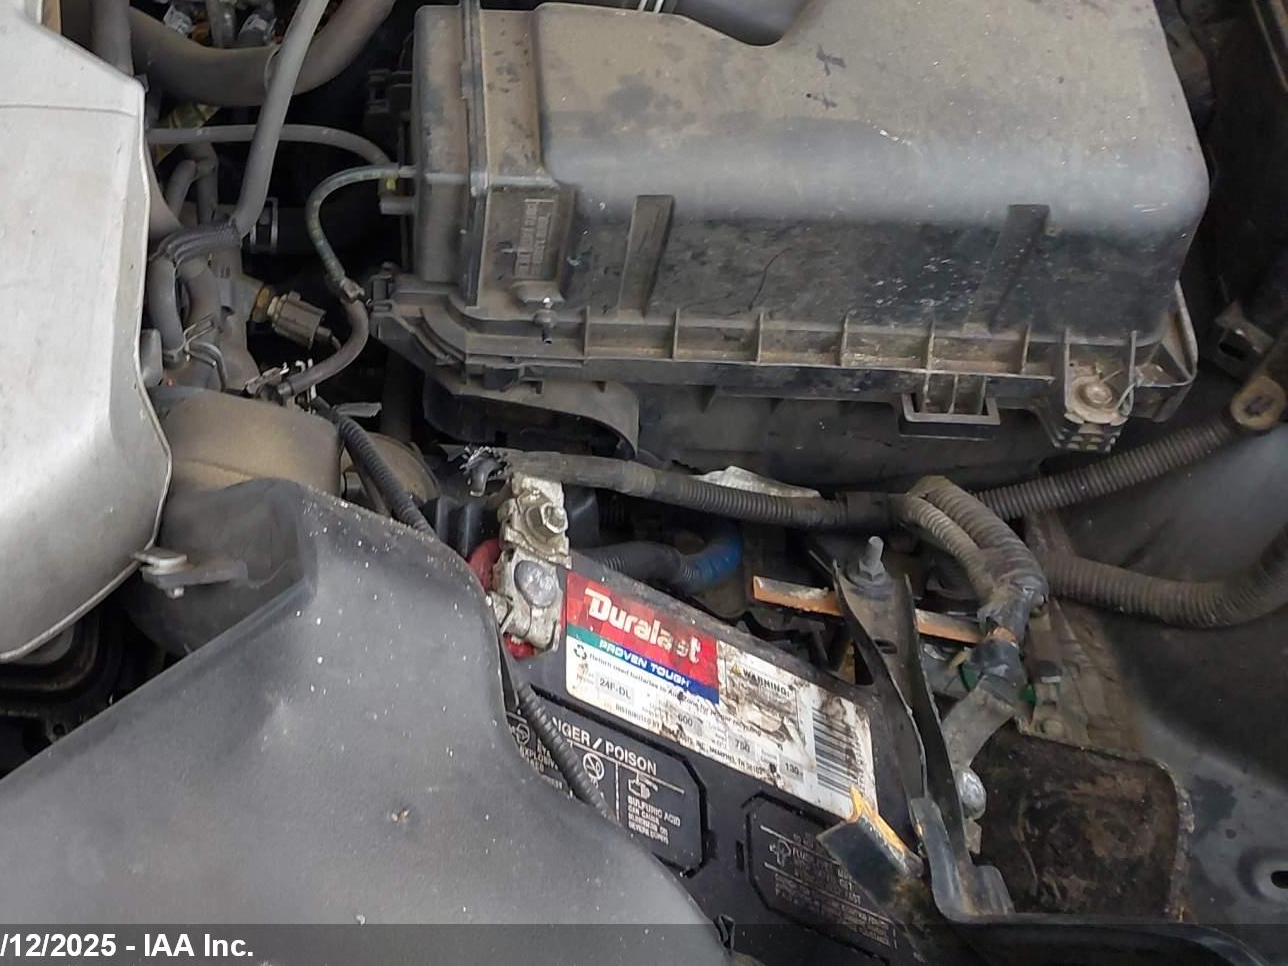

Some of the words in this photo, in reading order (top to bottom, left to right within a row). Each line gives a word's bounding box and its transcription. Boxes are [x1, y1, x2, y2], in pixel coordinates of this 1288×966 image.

[585, 588, 701, 663] Duralast
[599, 639, 648, 668] PROVEN
[650, 665, 691, 688] TOUGH
[606, 742, 657, 775] POISON
